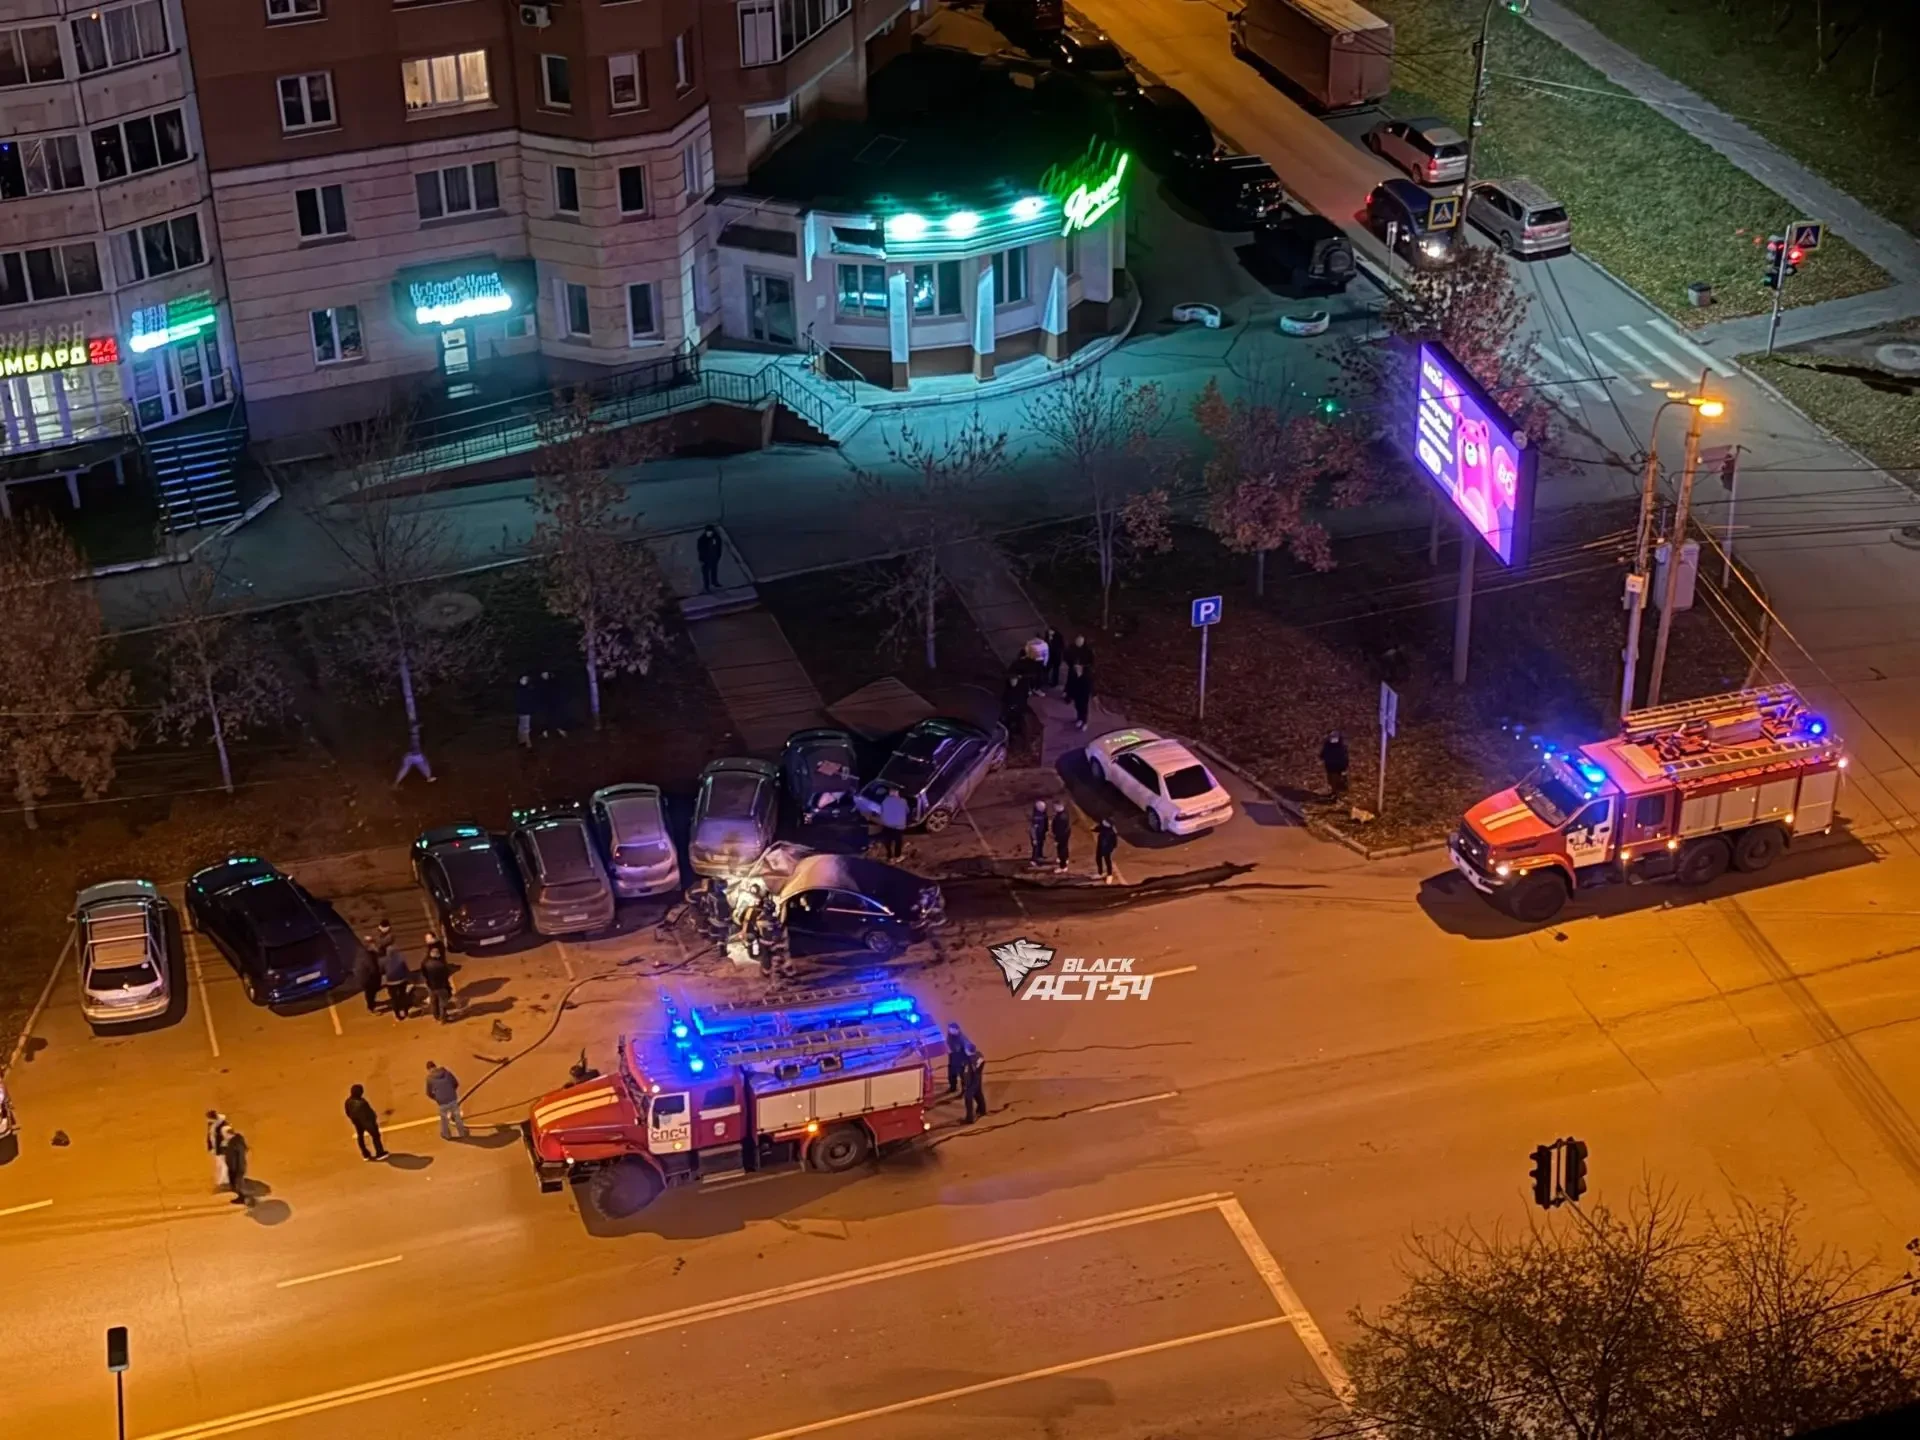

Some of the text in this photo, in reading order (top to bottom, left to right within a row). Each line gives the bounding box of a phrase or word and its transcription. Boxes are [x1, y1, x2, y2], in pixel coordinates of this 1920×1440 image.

[89, 338, 117, 356] 24
[1200, 602, 1216, 622] P
[650, 1127, 688, 1140] СПСЧ
